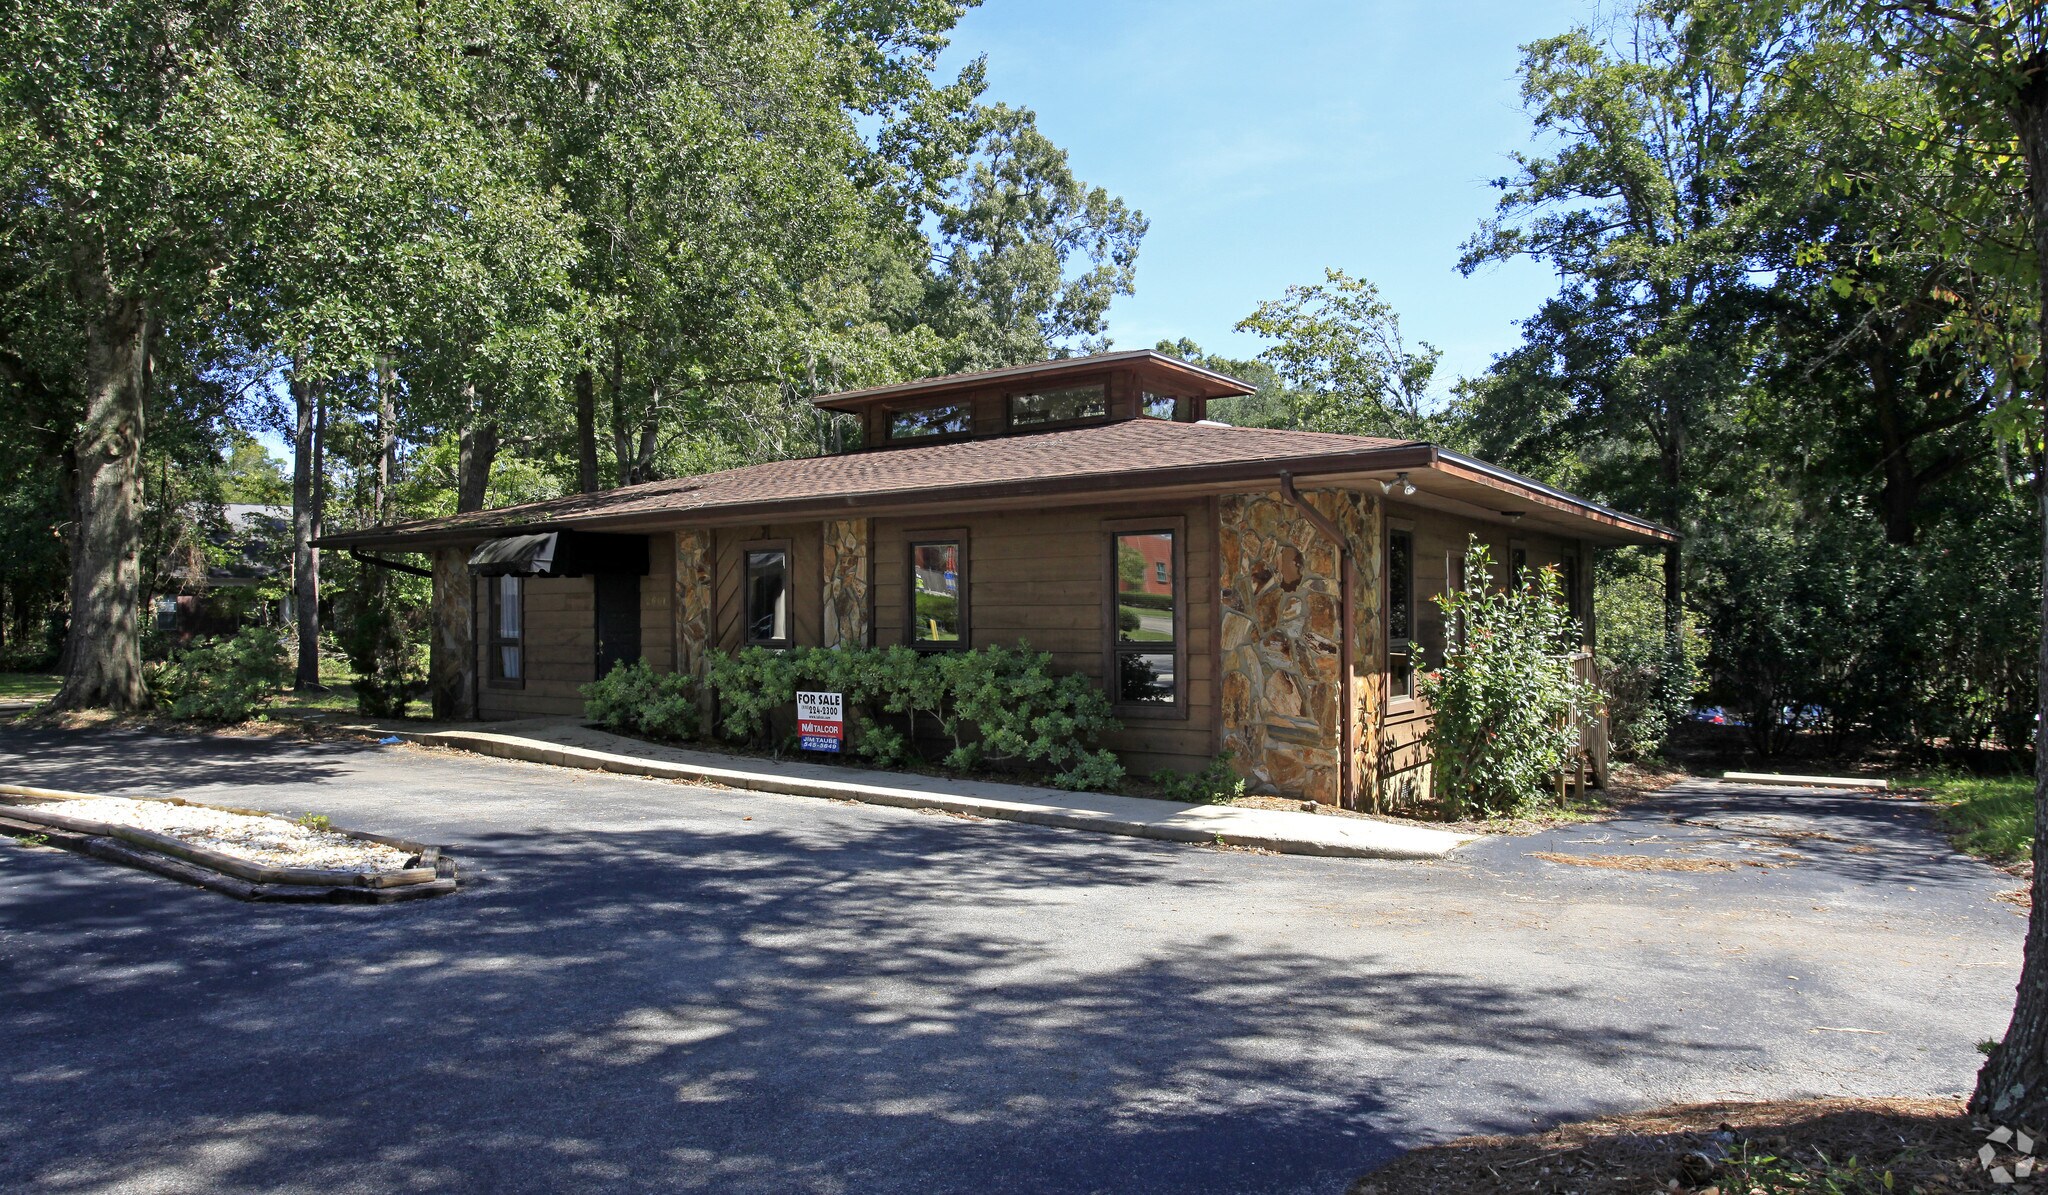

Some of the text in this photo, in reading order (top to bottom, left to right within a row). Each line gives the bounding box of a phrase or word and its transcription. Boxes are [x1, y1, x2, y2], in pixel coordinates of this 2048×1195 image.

[798, 694, 840, 705] FOR SALE
[809, 706, 838, 715] 224-2300
